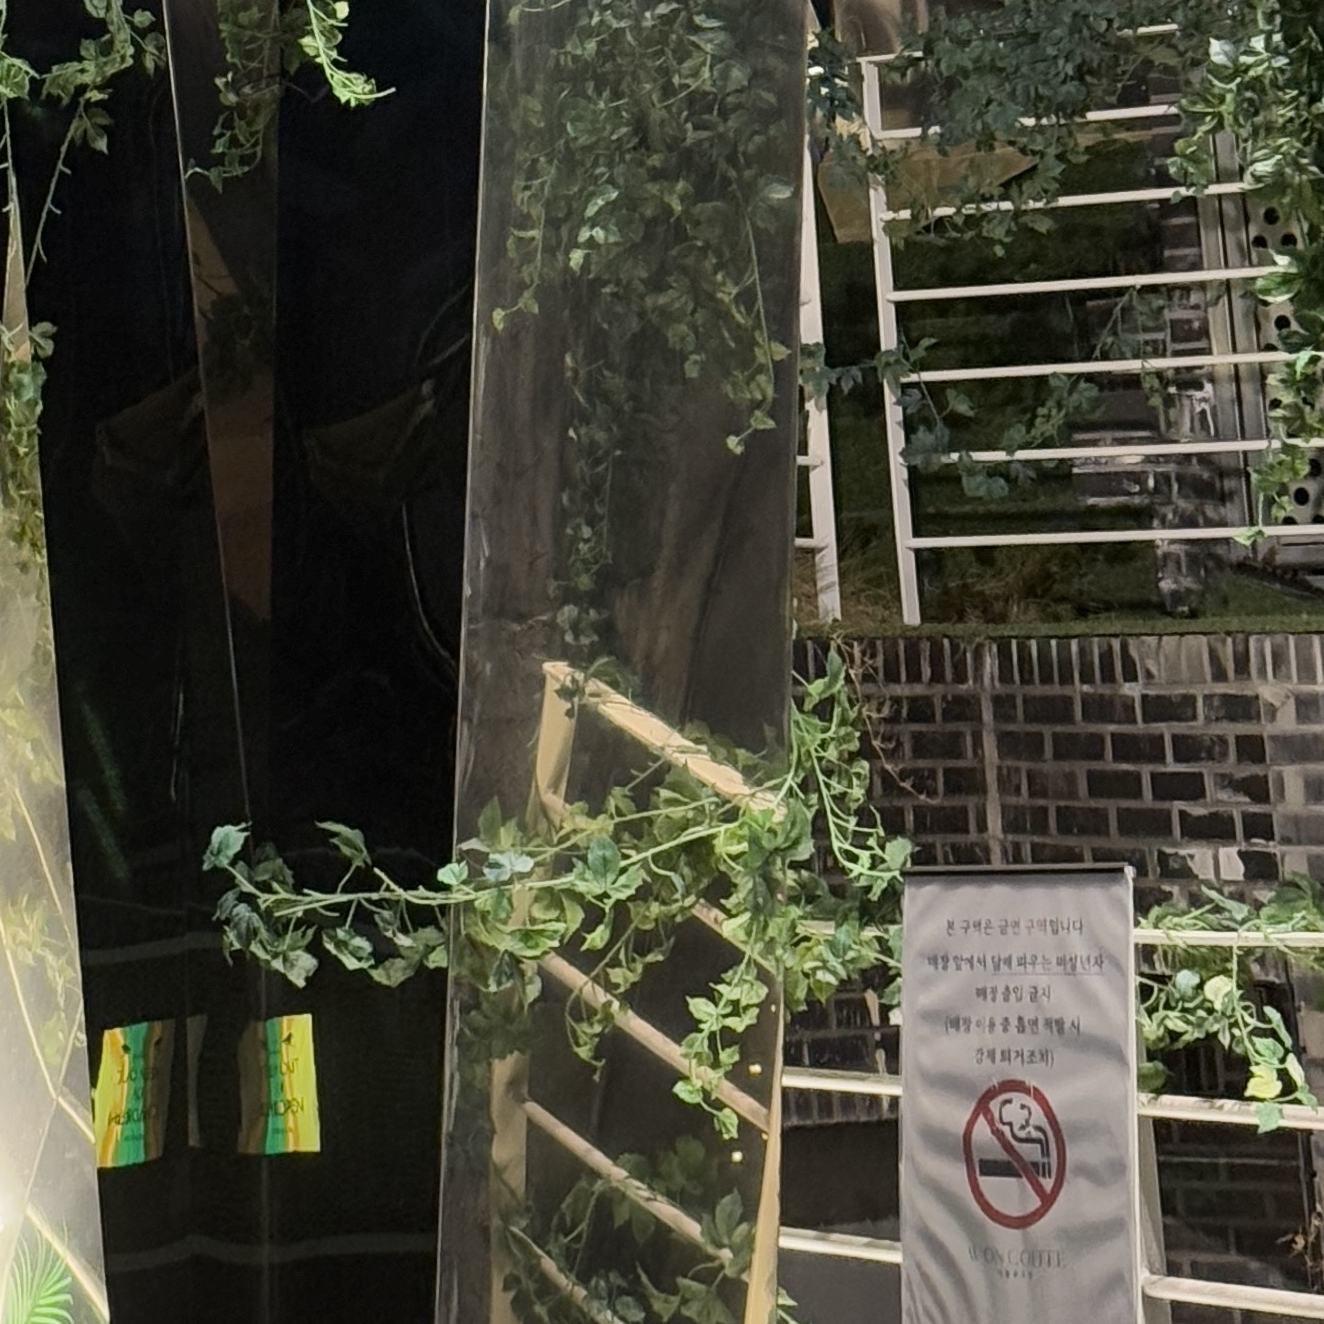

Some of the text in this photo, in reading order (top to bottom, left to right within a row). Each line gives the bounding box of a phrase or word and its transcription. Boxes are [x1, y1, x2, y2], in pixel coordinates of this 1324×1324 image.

[960, 918, 994, 936] 구역은
[998, 918, 1021, 936] 금연
[1025, 916, 1084, 936] 구역입니다
